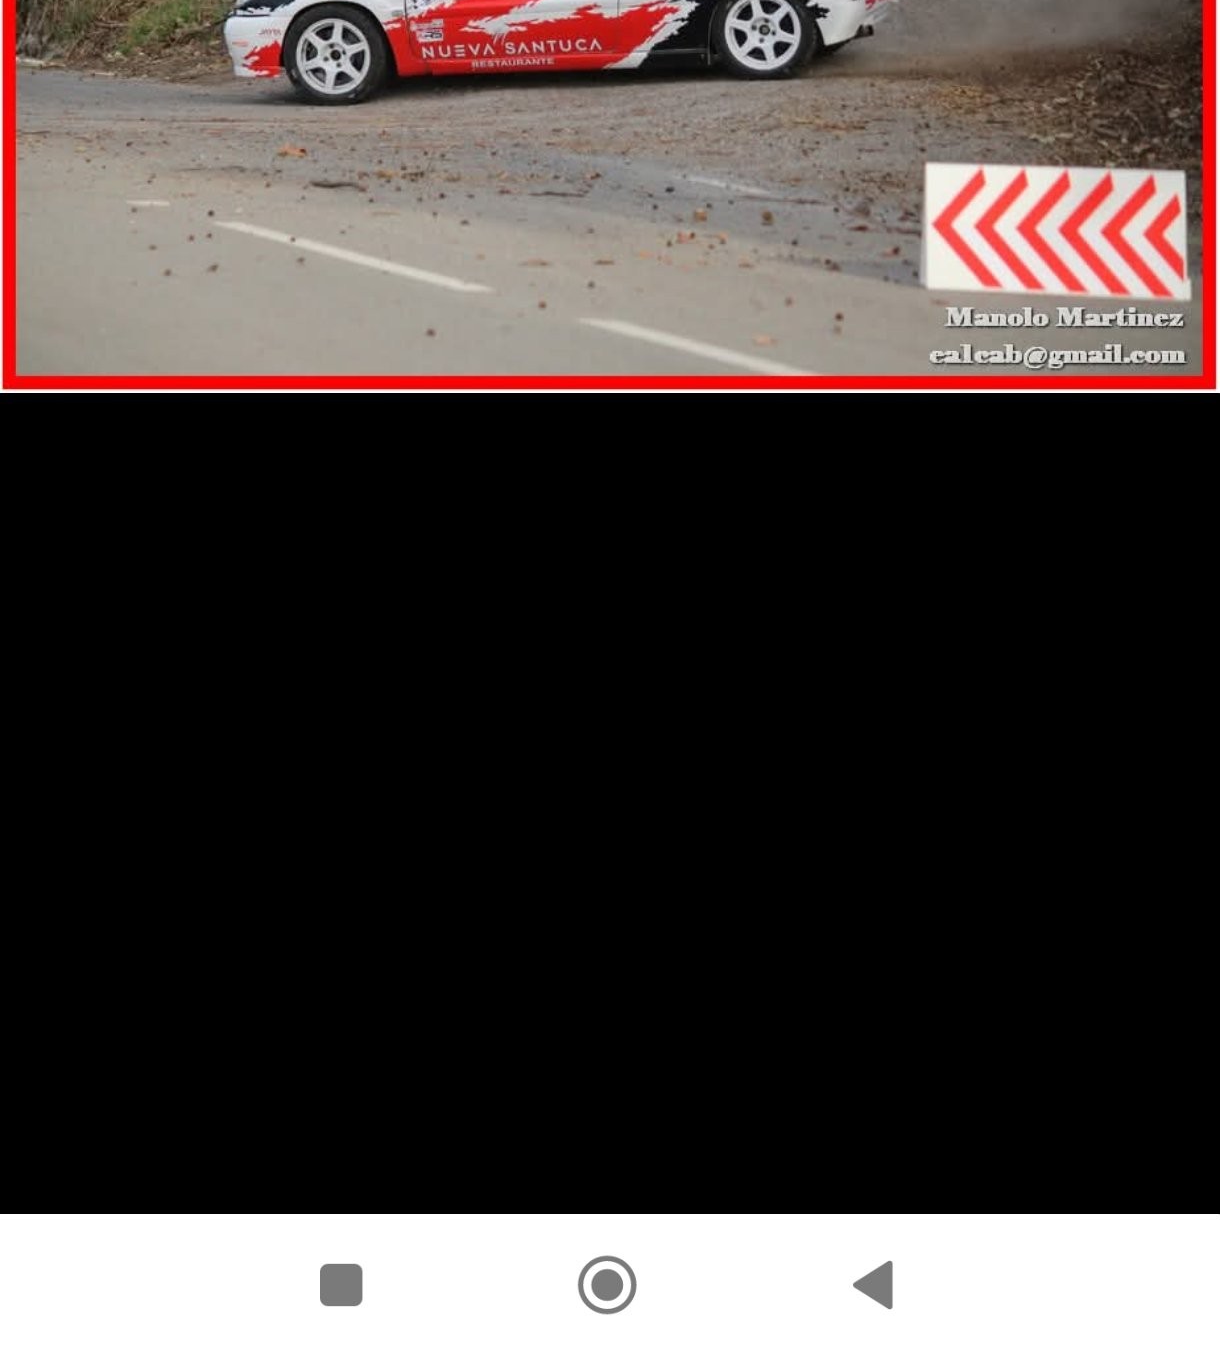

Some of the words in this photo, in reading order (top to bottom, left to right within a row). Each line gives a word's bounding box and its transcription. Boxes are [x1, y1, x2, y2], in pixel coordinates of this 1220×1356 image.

[422, 43, 496, 60] NUEVA
[505, 38, 602, 56] SANTUCA
[472, 56, 555, 70] RESTAURANTE
